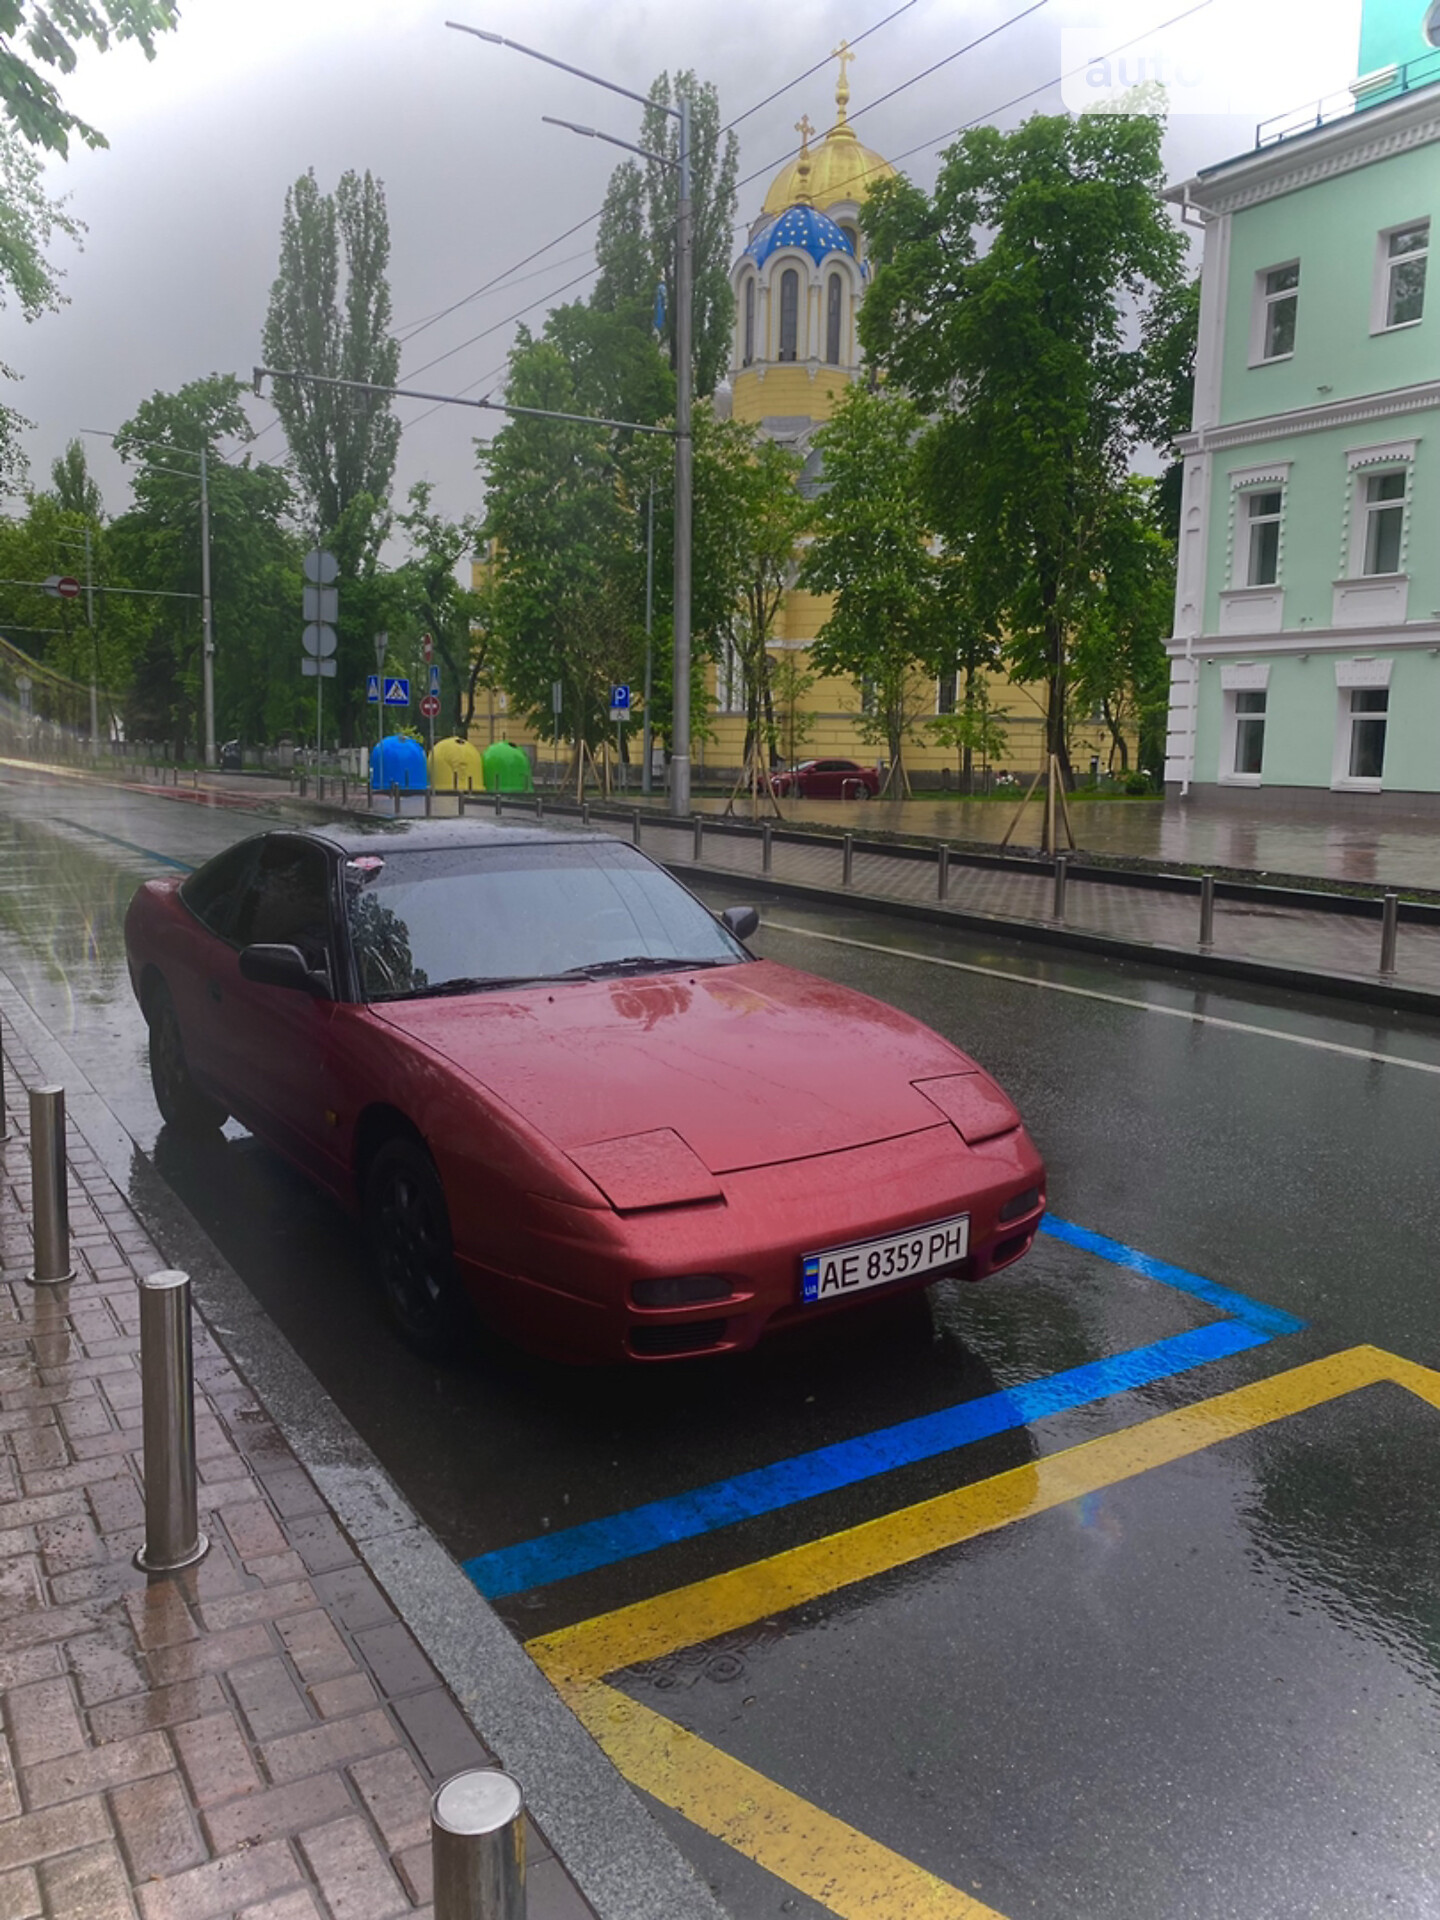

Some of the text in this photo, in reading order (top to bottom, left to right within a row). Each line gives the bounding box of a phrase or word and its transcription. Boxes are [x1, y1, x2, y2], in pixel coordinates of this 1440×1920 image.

[615, 687, 627, 705] P
[821, 1226, 961, 1293] AE 8359 PH
[805, 1285, 817, 1296] UA
